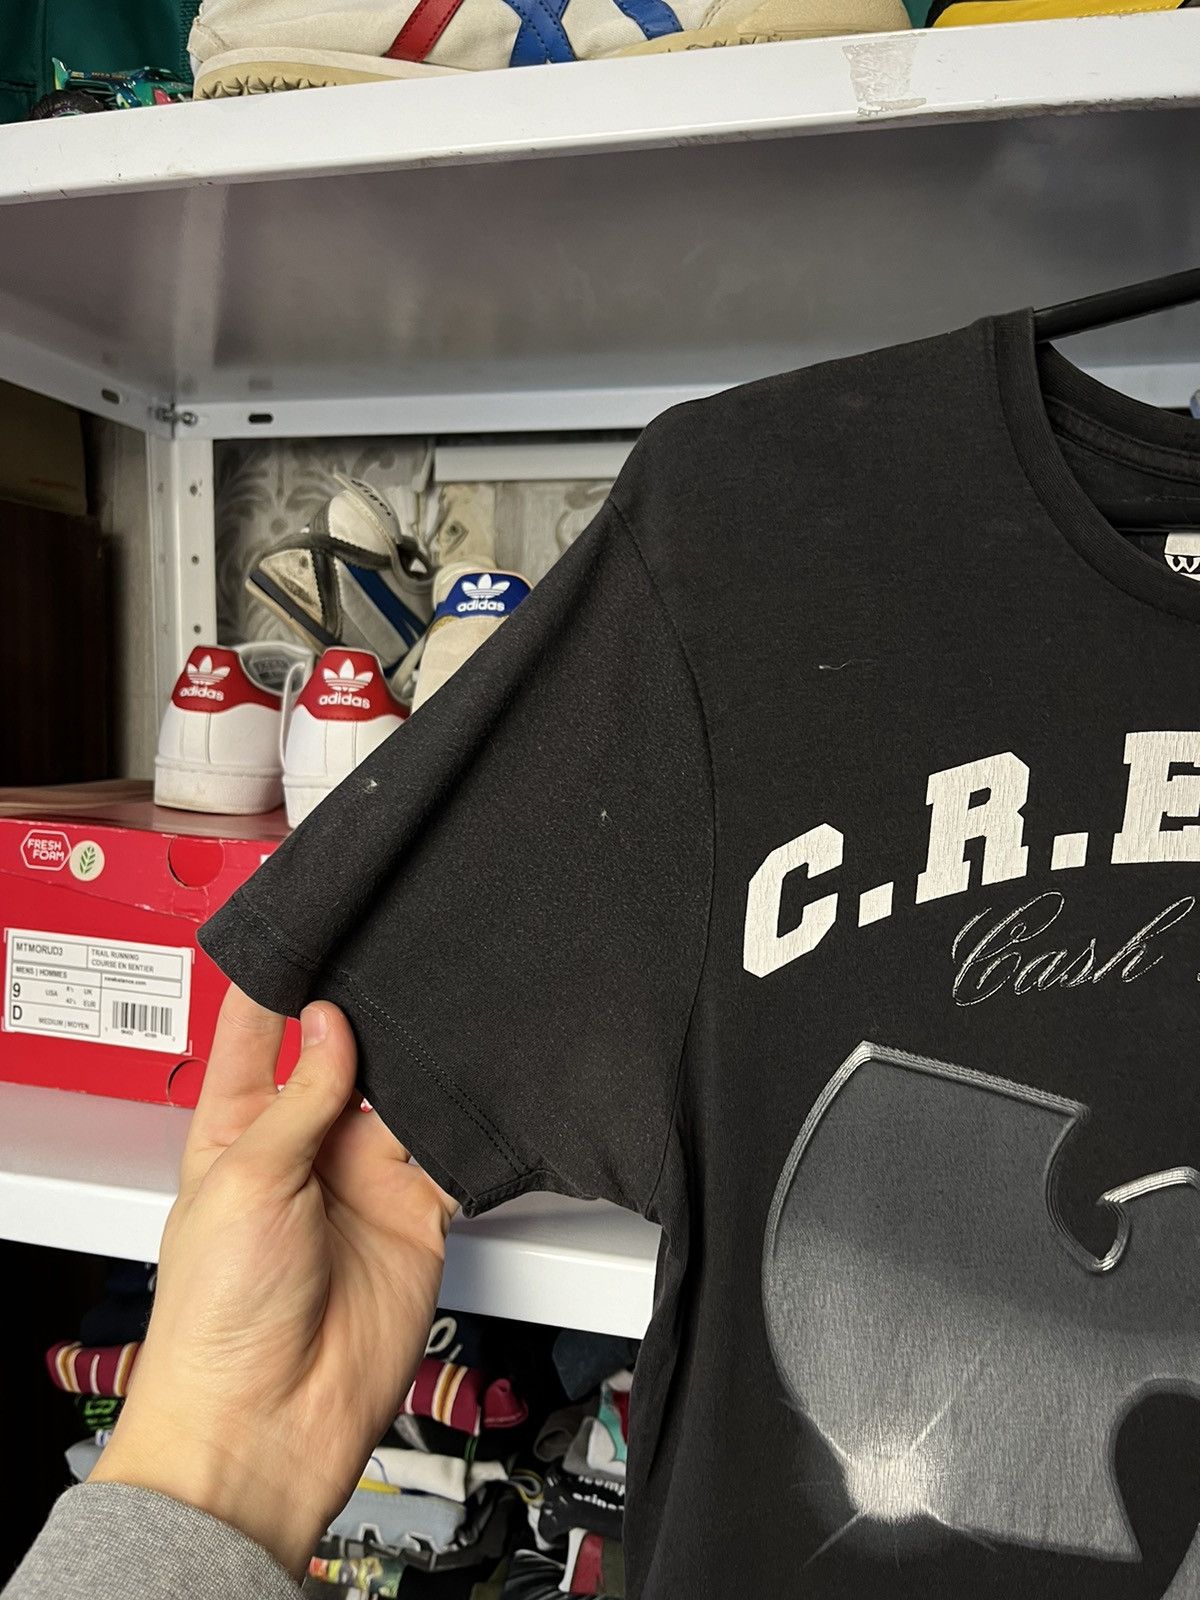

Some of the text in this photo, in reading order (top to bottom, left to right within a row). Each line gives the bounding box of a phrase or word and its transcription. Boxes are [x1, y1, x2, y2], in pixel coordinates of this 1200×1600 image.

[457, 599, 505, 612] adidas
[180, 686, 224, 701] adidas
[319, 691, 370, 709] adidas
[27, 838, 62, 851] FRESH
[33, 849, 65, 861] FOAM
[91, 948, 139, 961] TRAIL RUNNING
[952, 891, 1195, 1006] Cash
[16, 966, 34, 976] MENS
[40, 969, 67, 978] HOMMES
[91, 959, 154, 973] COURSE EN SENTIER
[13, 982, 21, 998] 9
[45, 989, 58, 997] USA
[13, 1005, 23, 1020] D
[39, 1017, 63, 1026] MEDIUM
[68, 1020, 89, 1030] MOYEN
